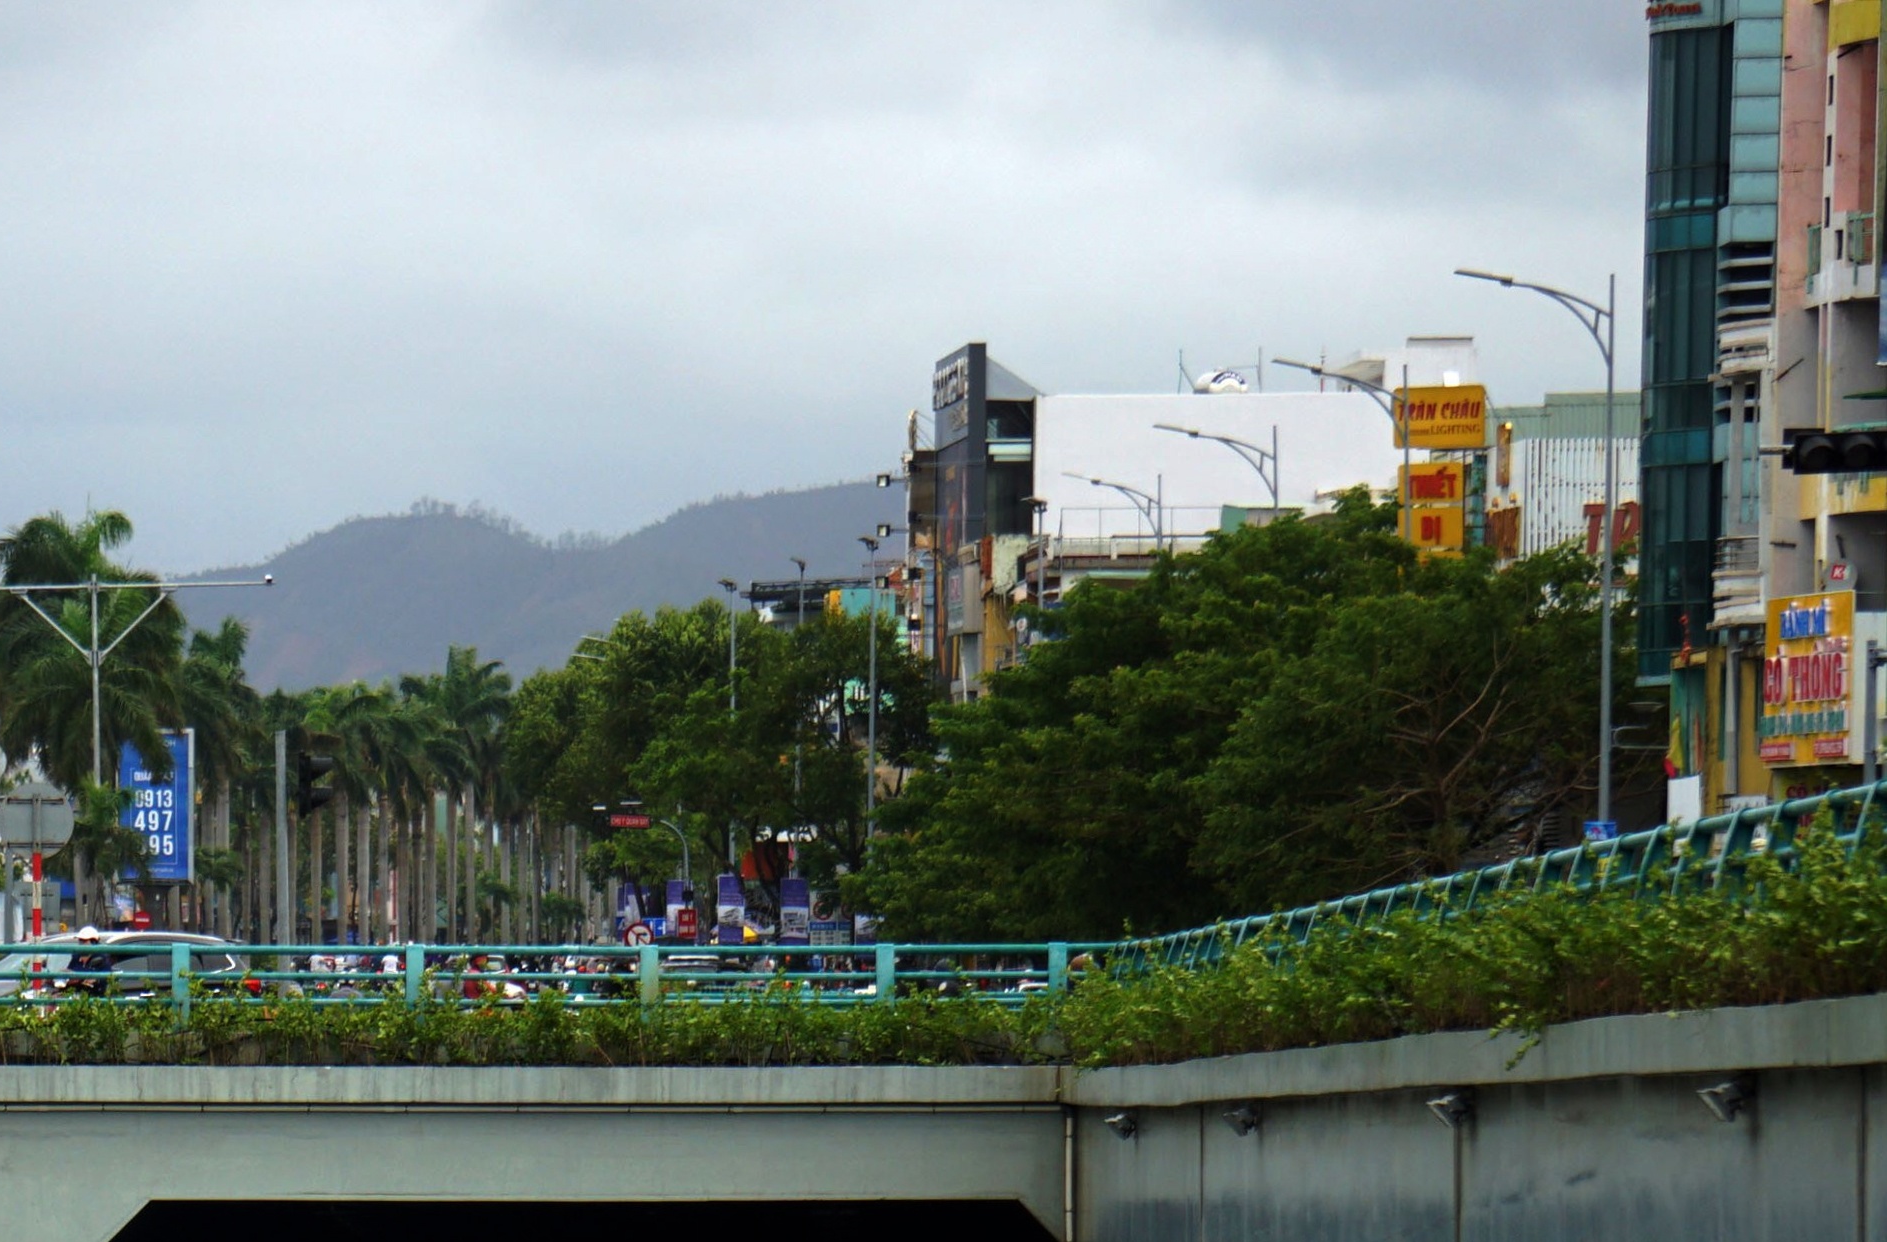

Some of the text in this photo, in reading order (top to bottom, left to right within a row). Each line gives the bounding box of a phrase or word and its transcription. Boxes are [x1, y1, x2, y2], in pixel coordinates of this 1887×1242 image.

[1441, 398, 1482, 419] CHÂU
[1430, 423, 1481, 436] LIGHTING
[1408, 466, 1457, 499] THIẾT
[135, 789, 173, 808] 0913
[134, 810, 173, 832] 497
